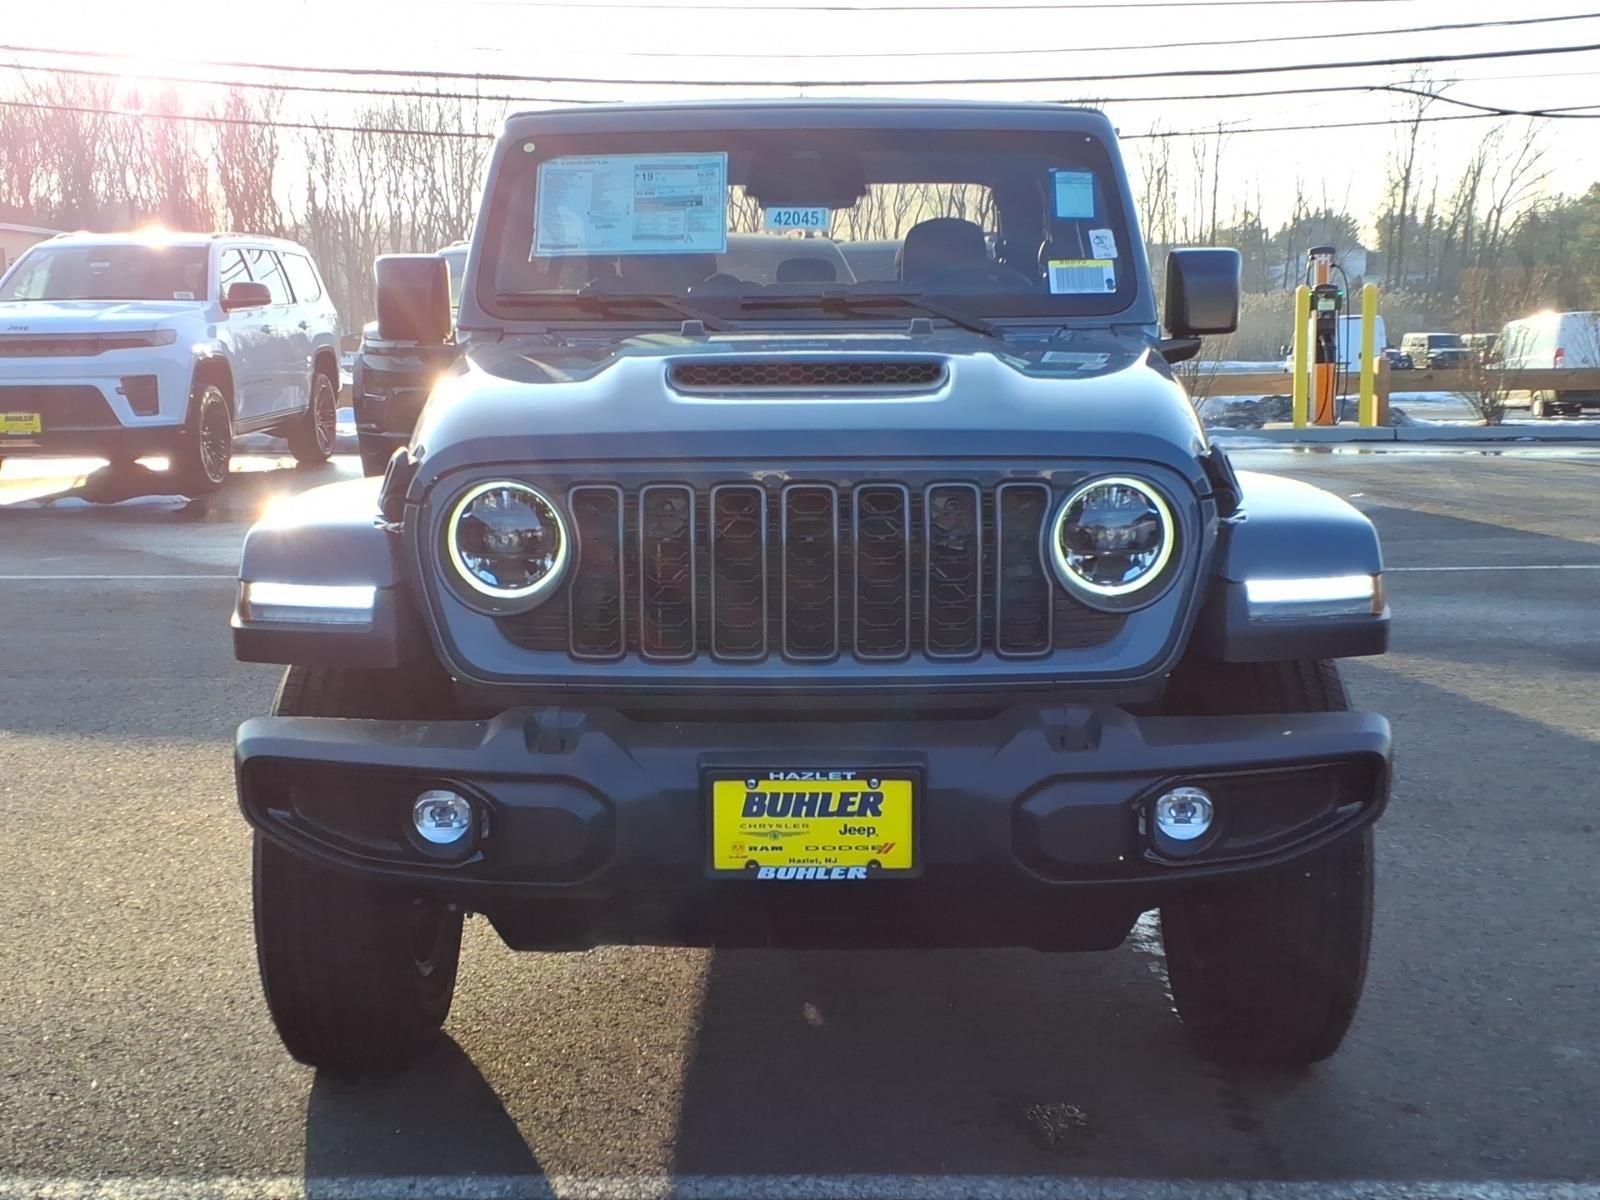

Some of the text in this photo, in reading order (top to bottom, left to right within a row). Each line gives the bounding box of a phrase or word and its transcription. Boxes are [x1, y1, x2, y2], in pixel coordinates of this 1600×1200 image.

[642, 172, 654, 181] 19
[774, 211, 819, 226] 42045
[769, 771, 856, 780] HAZLET
[741, 791, 884, 818] BUHLER
[838, 823, 876, 838] Jeep
[804, 844, 884, 852] DODGE
[756, 866, 868, 880] BUHLER
